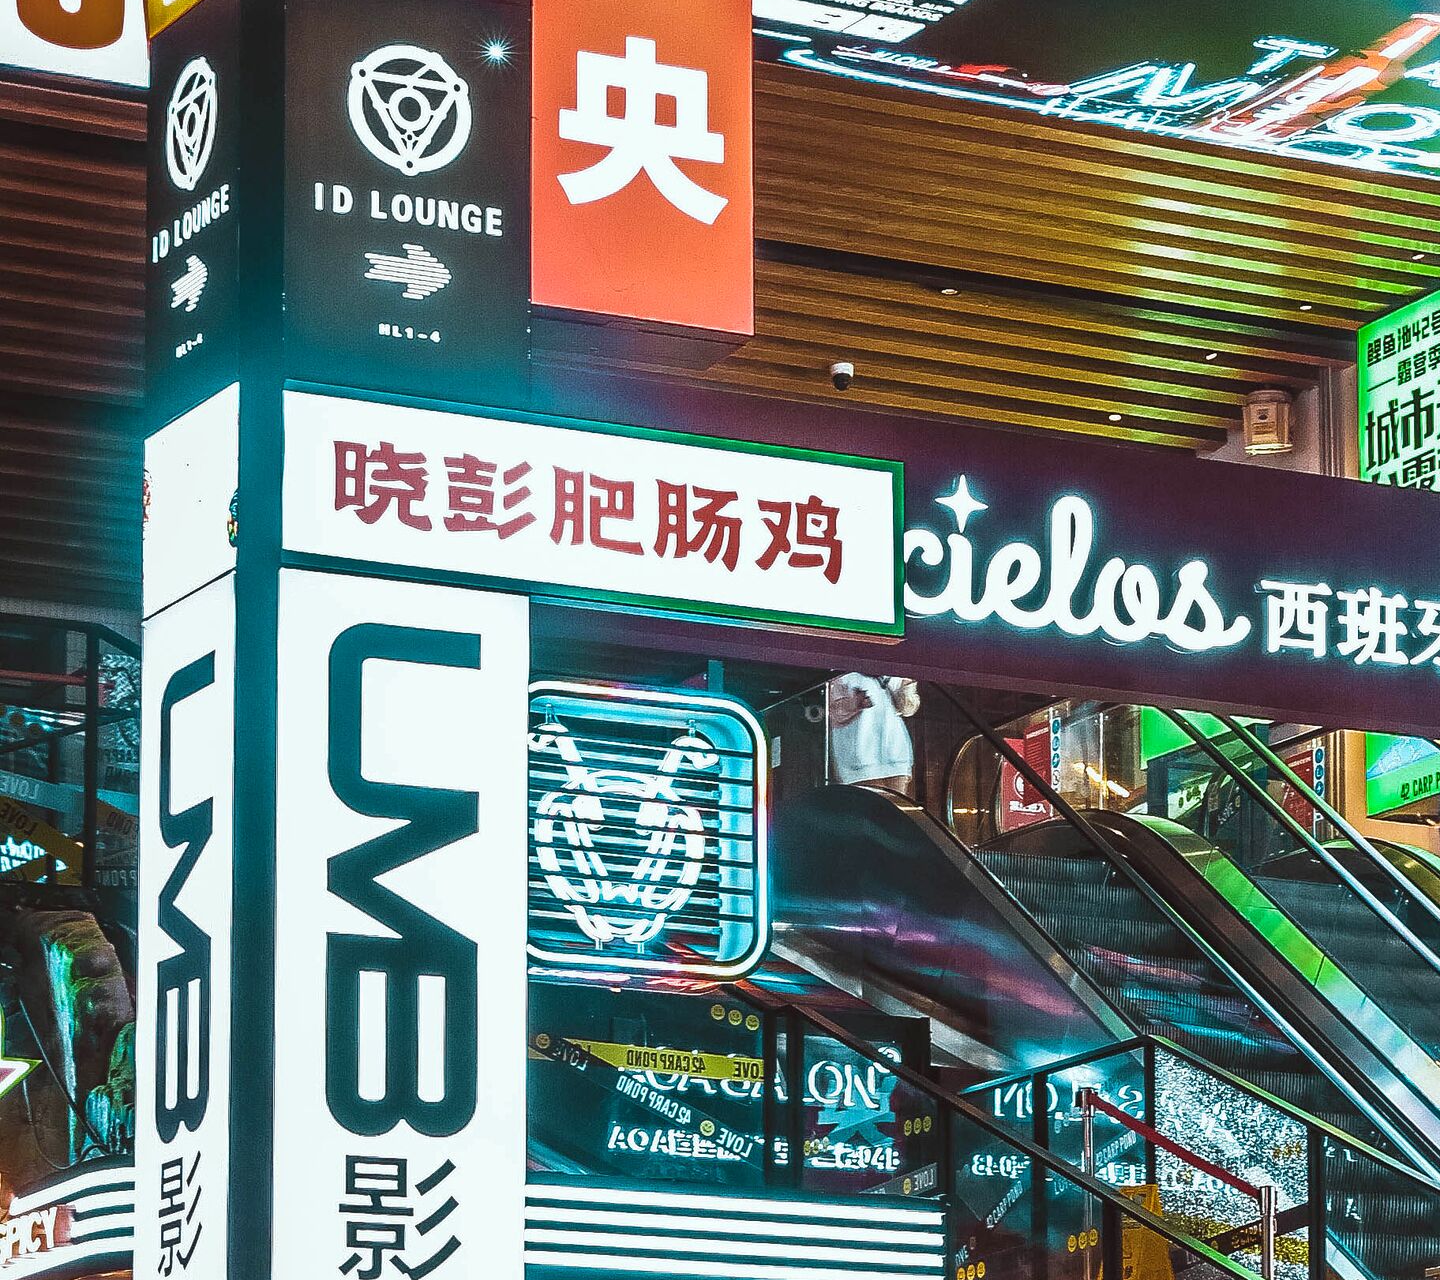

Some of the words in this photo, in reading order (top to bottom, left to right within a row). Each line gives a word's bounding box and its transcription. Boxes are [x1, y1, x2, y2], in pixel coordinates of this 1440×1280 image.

[151, 227, 170, 263] ID
[172, 183, 231, 249] LOUNGE
[314, 181, 355, 214] ID
[370, 188, 505, 239] LOUNGE
[334, 440, 843, 583] 晓彭肥肠鸡
[1400, 782, 1411, 801] 42
[1412, 777, 1434, 797] CARP
